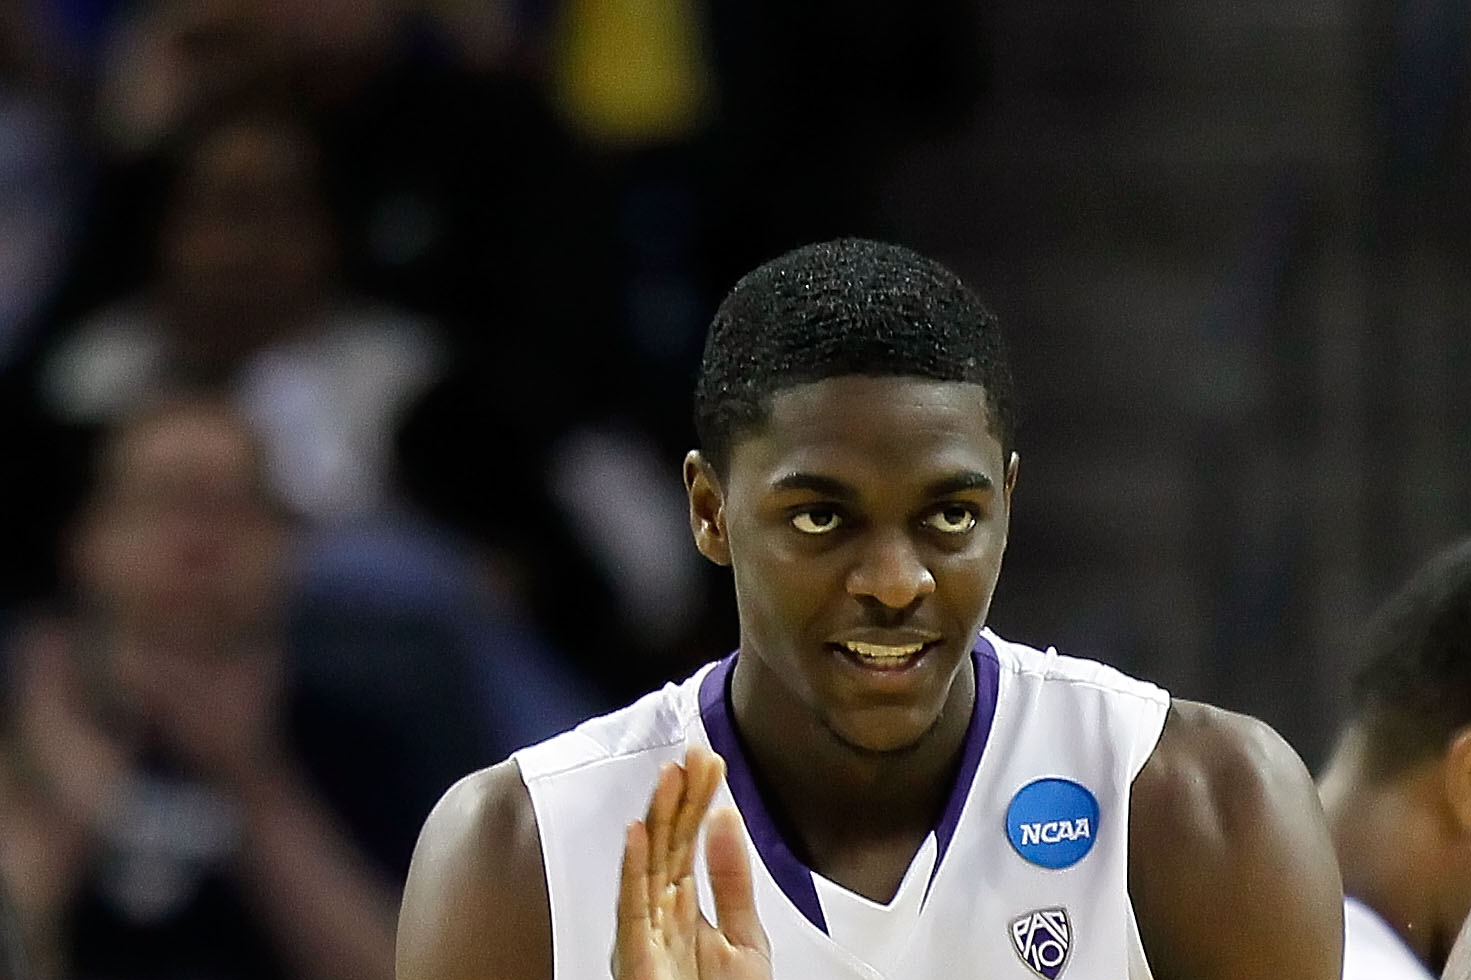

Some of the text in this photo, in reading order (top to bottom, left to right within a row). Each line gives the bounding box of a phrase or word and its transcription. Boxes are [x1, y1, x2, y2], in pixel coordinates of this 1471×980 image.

[1020, 817, 1090, 845] NCAA
[1012, 910, 1069, 960] PAC
[1031, 939, 1065, 971] 10
